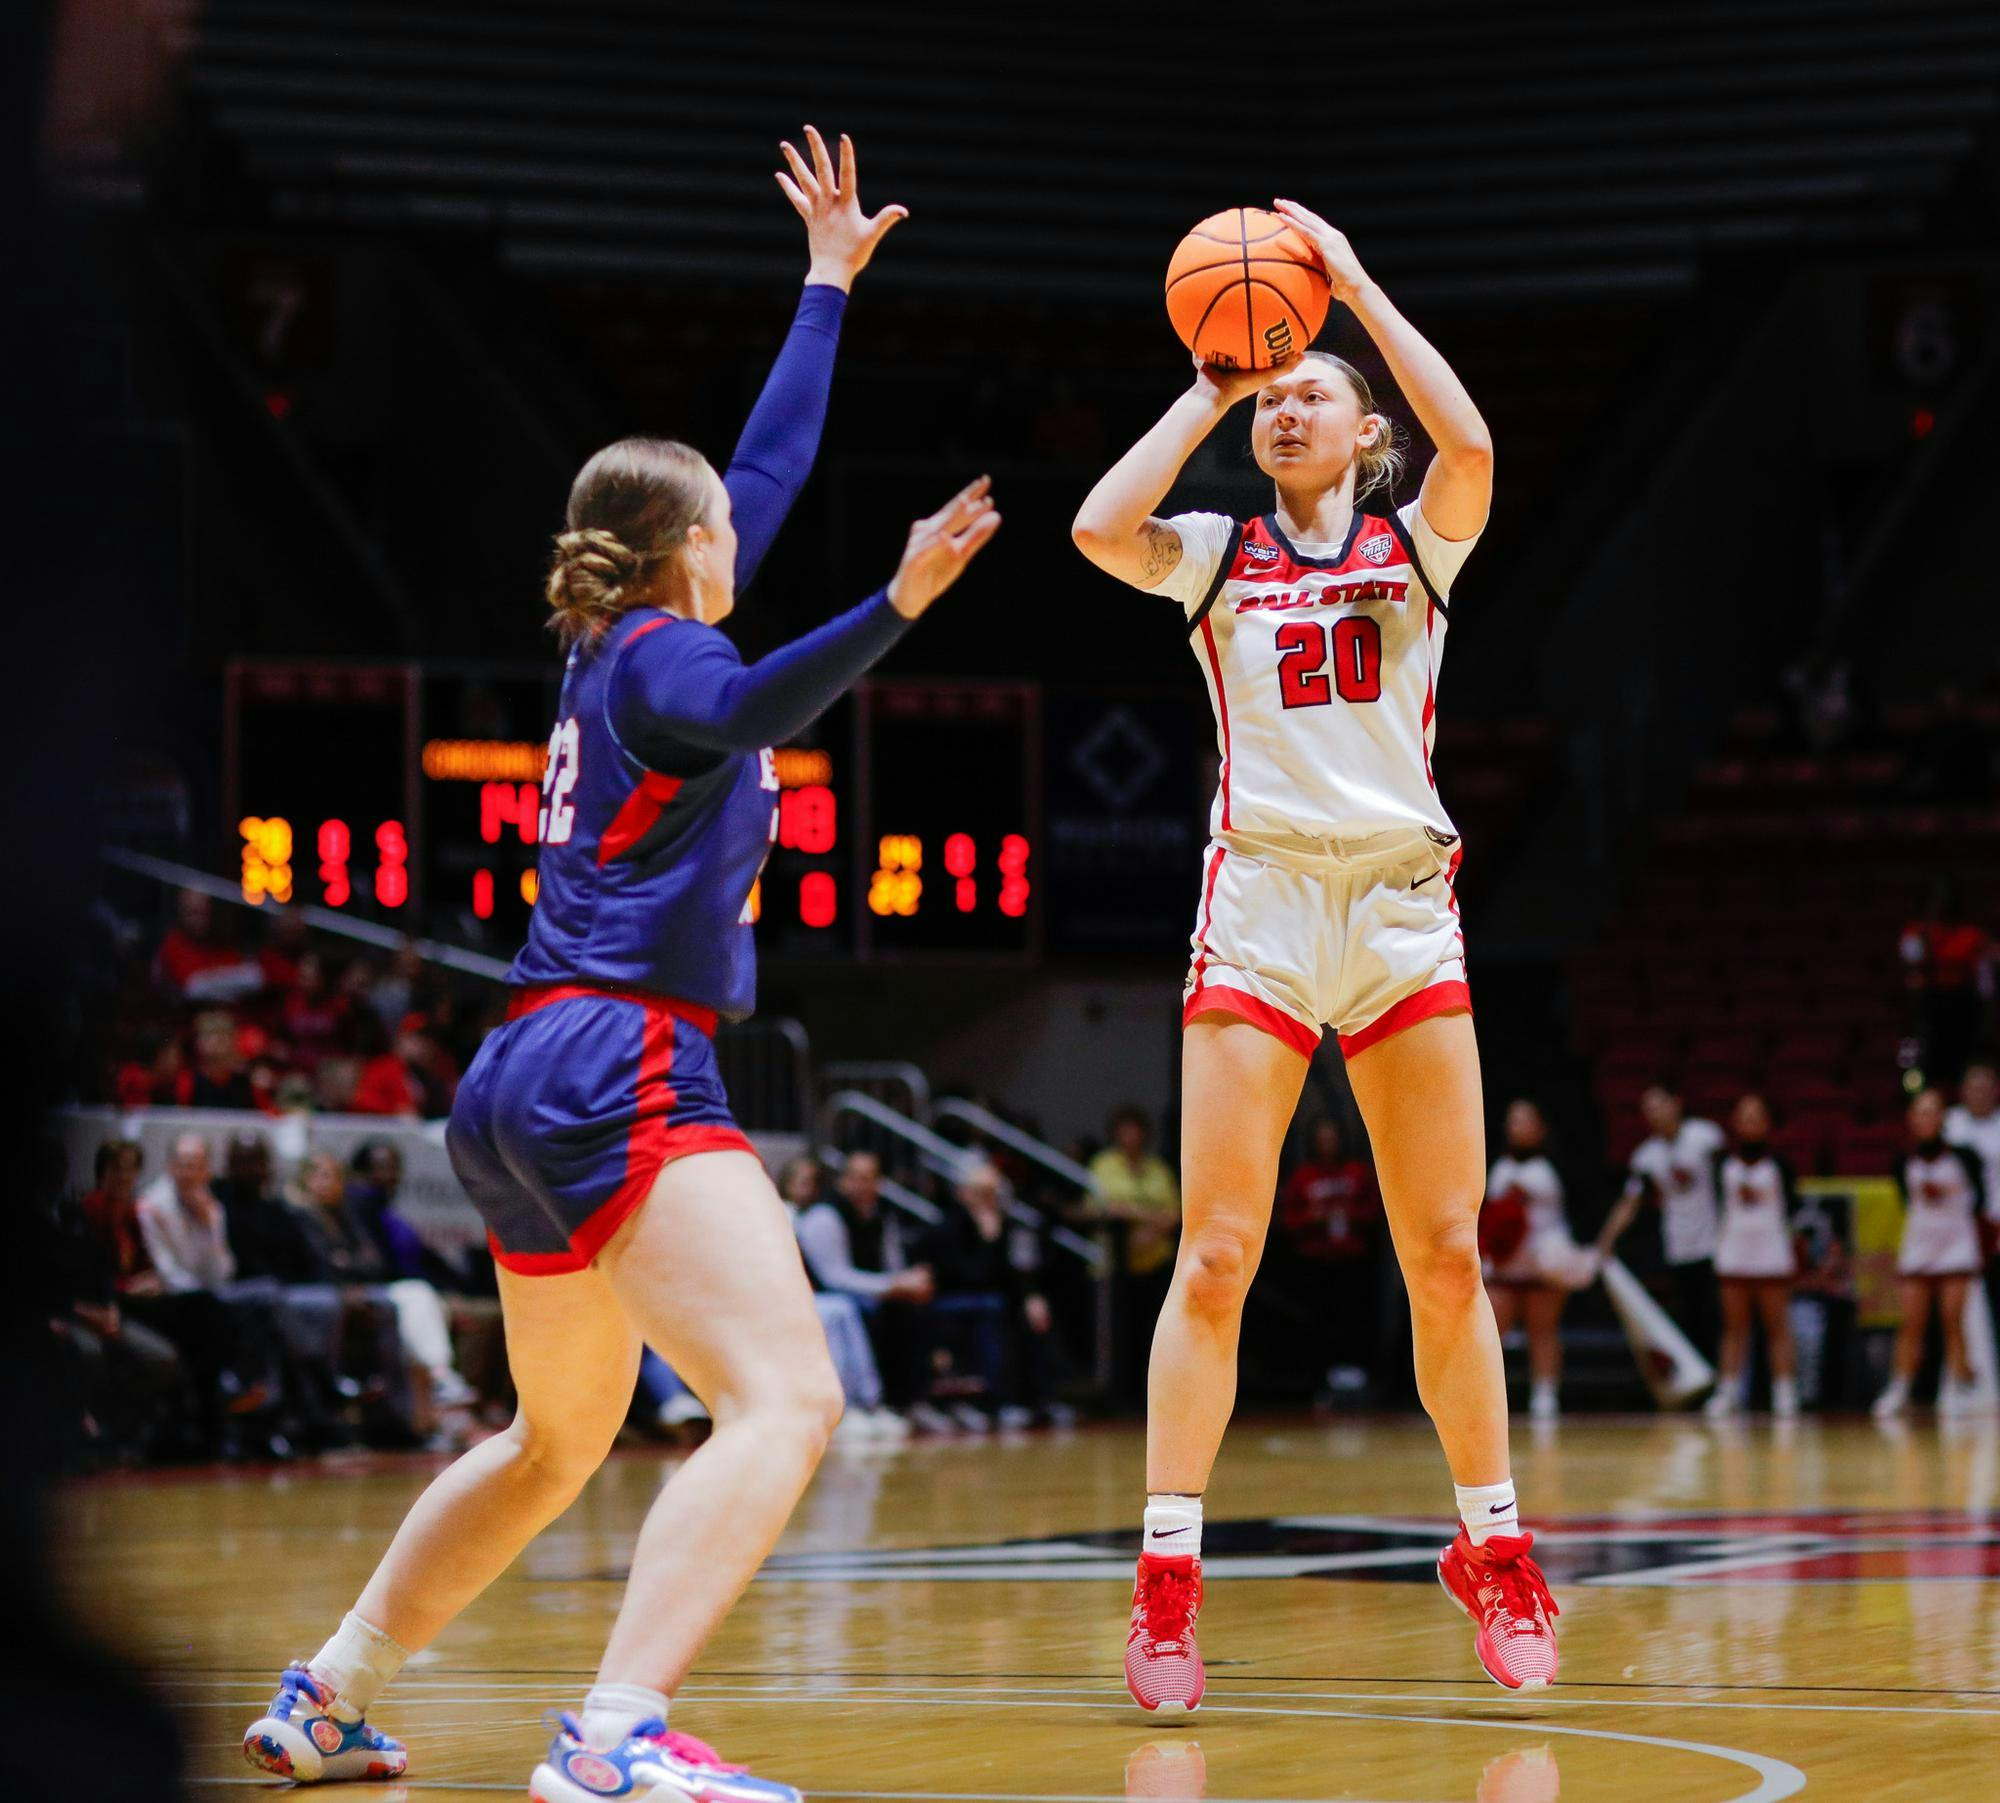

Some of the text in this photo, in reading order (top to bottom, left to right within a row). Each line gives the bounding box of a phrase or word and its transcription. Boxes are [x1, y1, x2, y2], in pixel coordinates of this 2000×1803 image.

[1235, 580, 1408, 614] BALL STATE
[1275, 615, 1382, 709] 20
